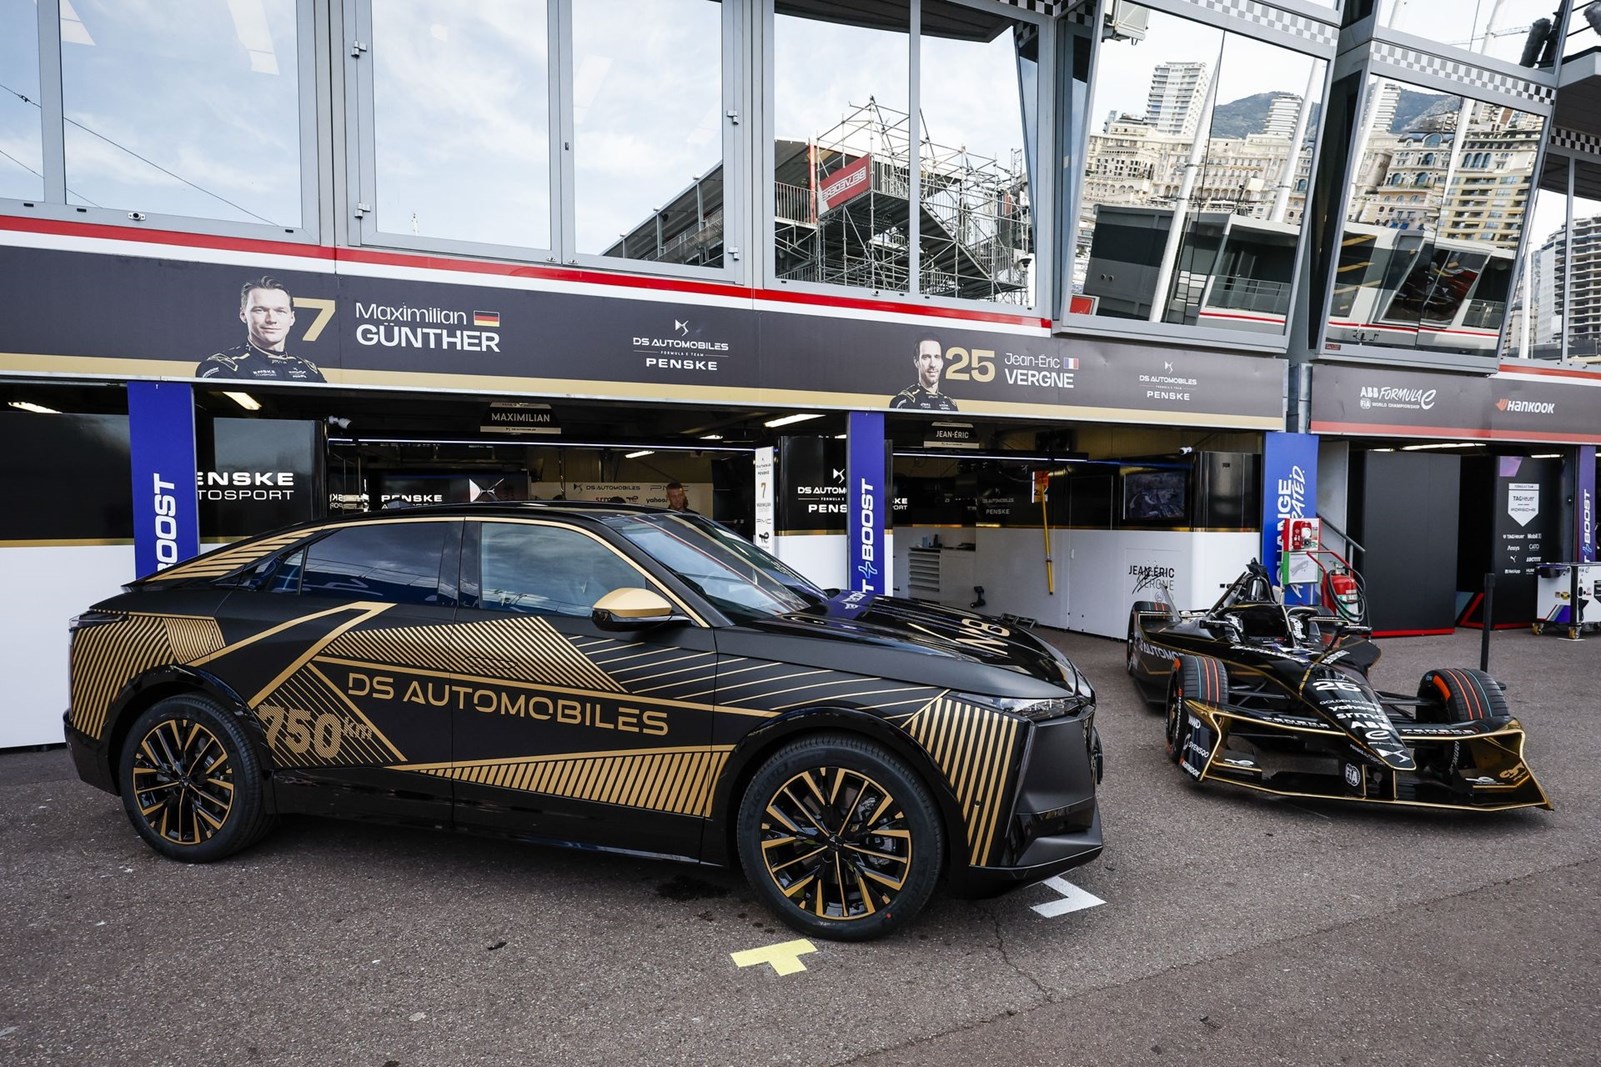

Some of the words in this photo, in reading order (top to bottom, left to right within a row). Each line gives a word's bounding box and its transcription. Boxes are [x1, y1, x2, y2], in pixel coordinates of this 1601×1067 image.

[289, 297, 336, 342] 7
[355, 302, 467, 325] Maximilian
[356, 323, 501, 353] GÜNTHER
[633, 337, 649, 346] DS
[651, 338, 729, 351] AUTOMOBILES
[646, 357, 718, 371] PENSKE
[944, 347, 996, 382] 25
[1004, 352, 1061, 371] Jean-Éric
[1004, 368, 1075, 389] VERGNE
[1150, 376, 1197, 386] AUTOMOBILES
[1146, 390, 1190, 401] PENSKE
[1360, 386, 1379, 398] ABB
[1379, 386, 1422, 402] FORMULA
[491, 412, 551, 423] MAXIMILIAN
[935, 430, 970, 439] JEAN-ÉRIC
[797, 486, 812, 494] DS
[808, 504, 847, 513] PENS
[861, 478, 874, 562] BOOST
[1128, 564, 1175, 578] JEAN-ÉRIC
[1312, 681, 1361, 692] 25
[348, 672, 394, 700] DS
[403, 680, 669, 737] AUTOMOBILES
[1188, 741, 1210, 758] SYENSQO
